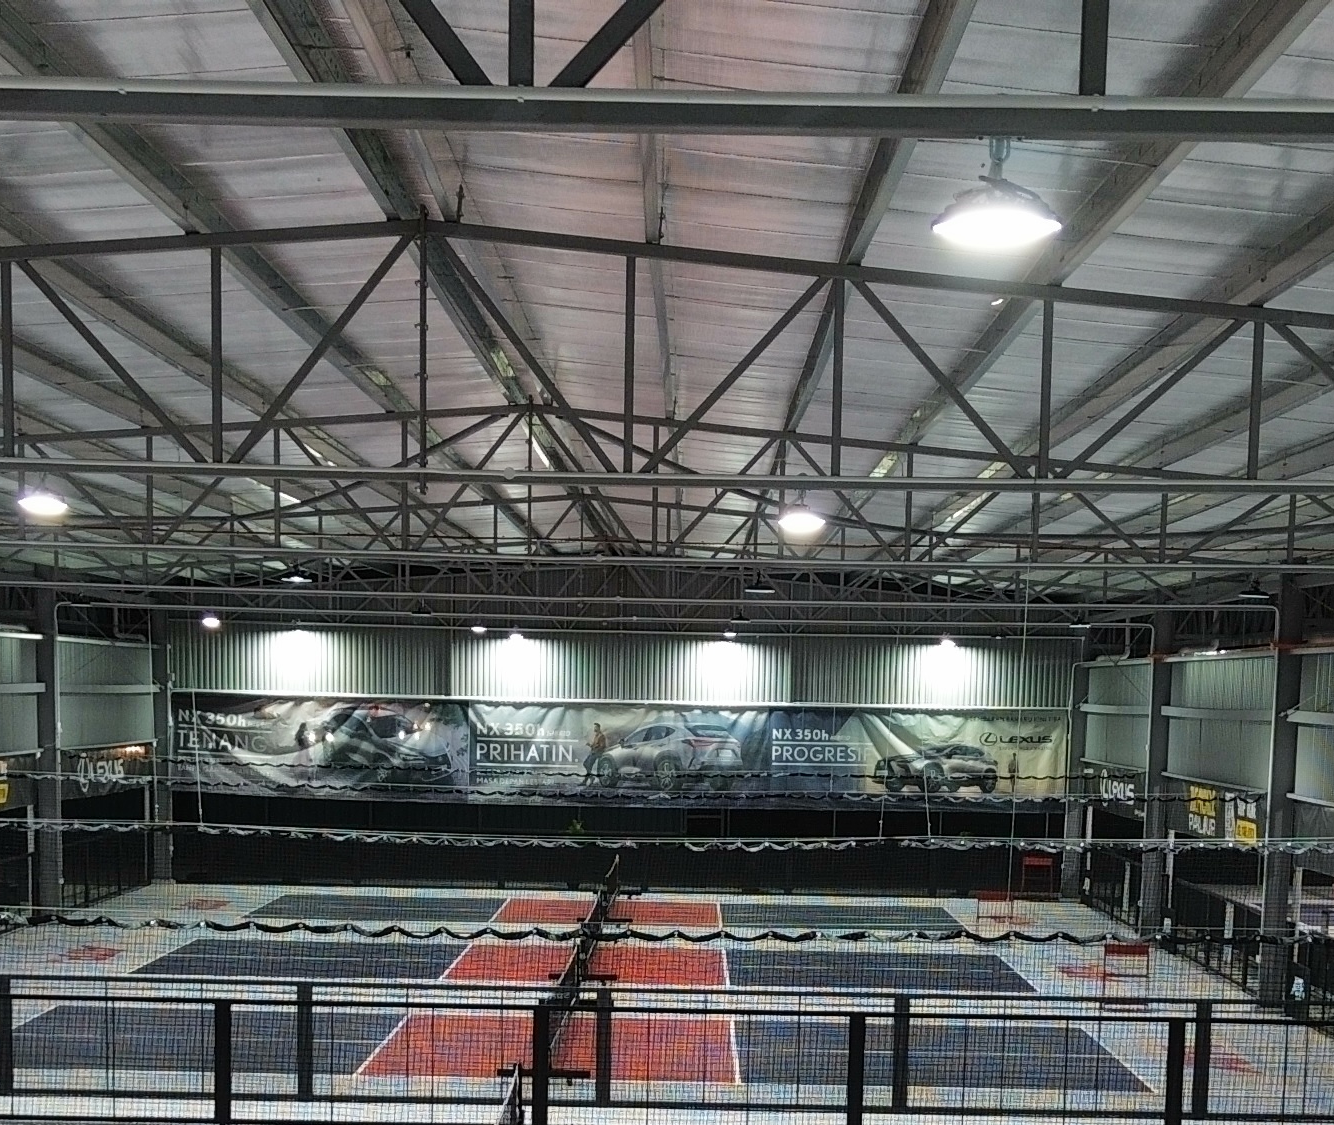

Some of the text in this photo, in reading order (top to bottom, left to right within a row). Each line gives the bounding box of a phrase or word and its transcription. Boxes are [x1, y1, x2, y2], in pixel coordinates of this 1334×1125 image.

[207, 712, 246, 727] 350h
[476, 722, 500, 736] NX
[504, 723, 545, 737] 350h
[772, 728, 793, 740] NX
[795, 729, 829, 741] 350h
[1000, 735, 1053, 744] LEXUS
[476, 742, 579, 762] PRIHATIN.
